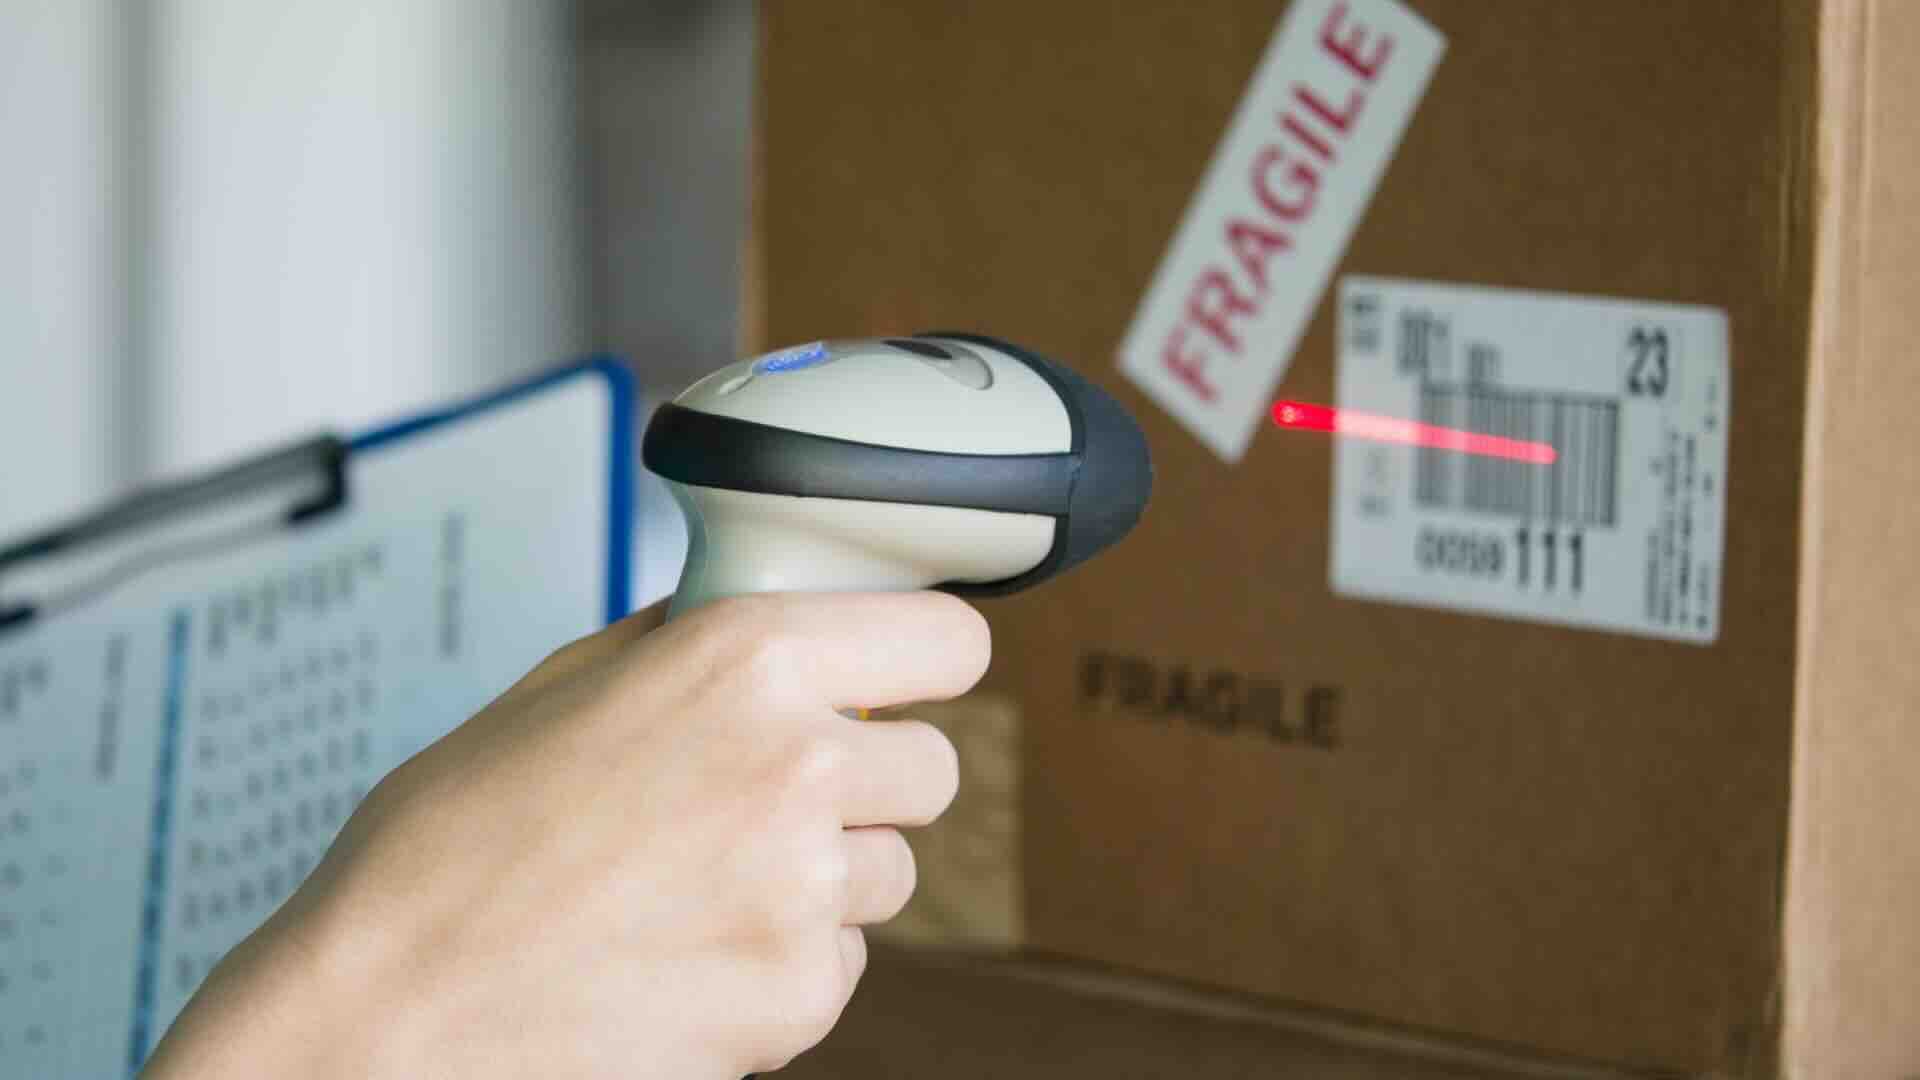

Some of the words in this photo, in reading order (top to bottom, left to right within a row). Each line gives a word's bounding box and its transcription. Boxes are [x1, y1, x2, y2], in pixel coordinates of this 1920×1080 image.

[1160, 0, 1396, 407] FRAGILE
[1625, 326, 1671, 398] 23
[1077, 651, 1344, 751] FRAGILE
